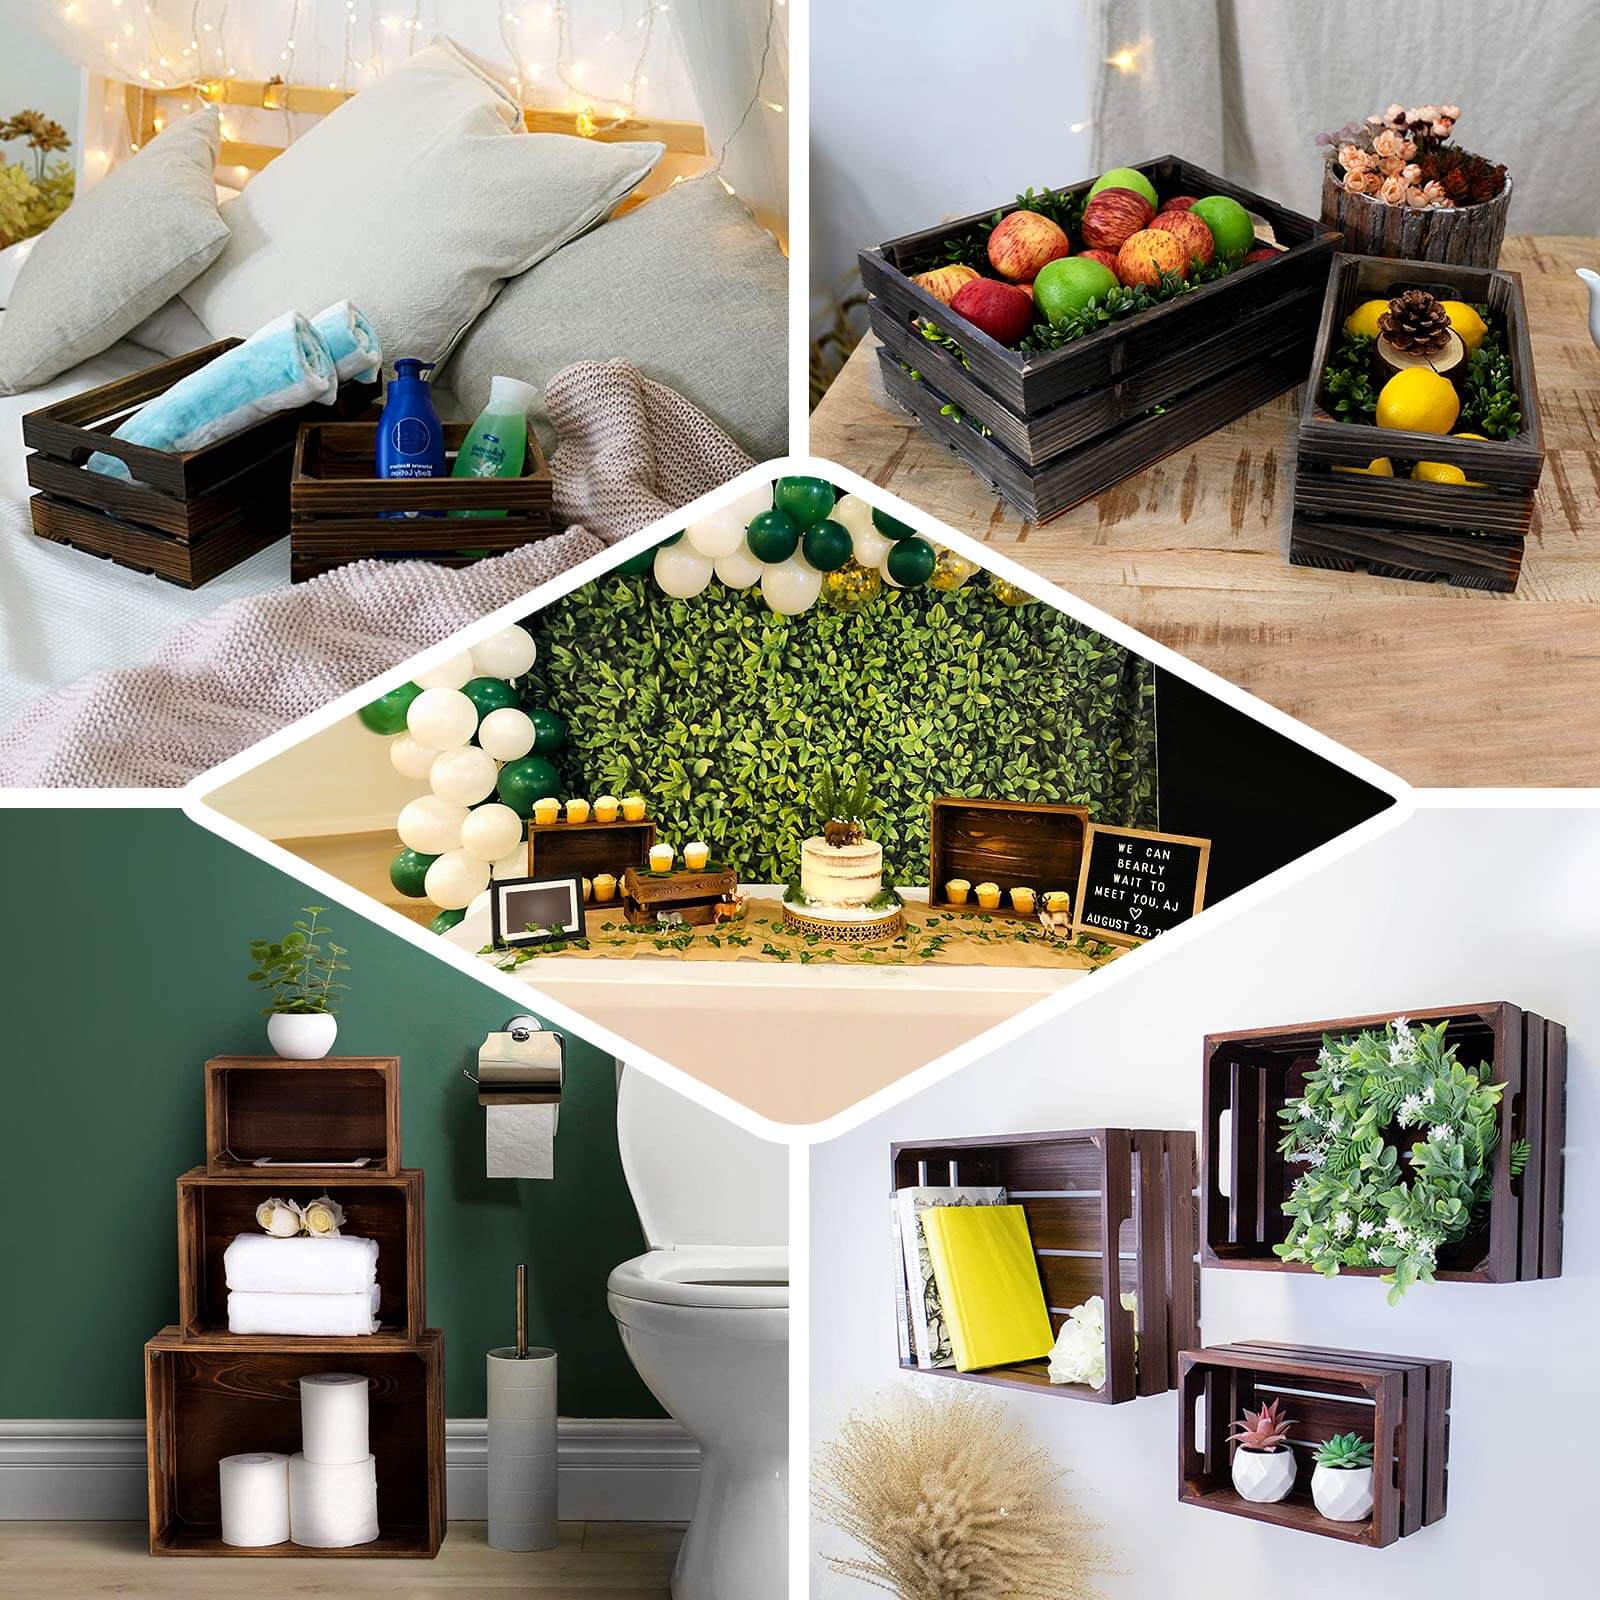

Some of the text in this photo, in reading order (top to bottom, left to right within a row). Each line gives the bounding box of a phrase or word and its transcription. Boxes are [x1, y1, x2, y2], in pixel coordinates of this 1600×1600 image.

[1118, 843, 1171, 860] WE CAN
[1117, 858, 1165, 876] BEARLY
[1113, 873, 1165, 893] WAIT TO
[1094, 885, 1126, 900] MEET
[1162, 899, 1179, 912] AJ
[1086, 912, 1129, 931] AUGUST
